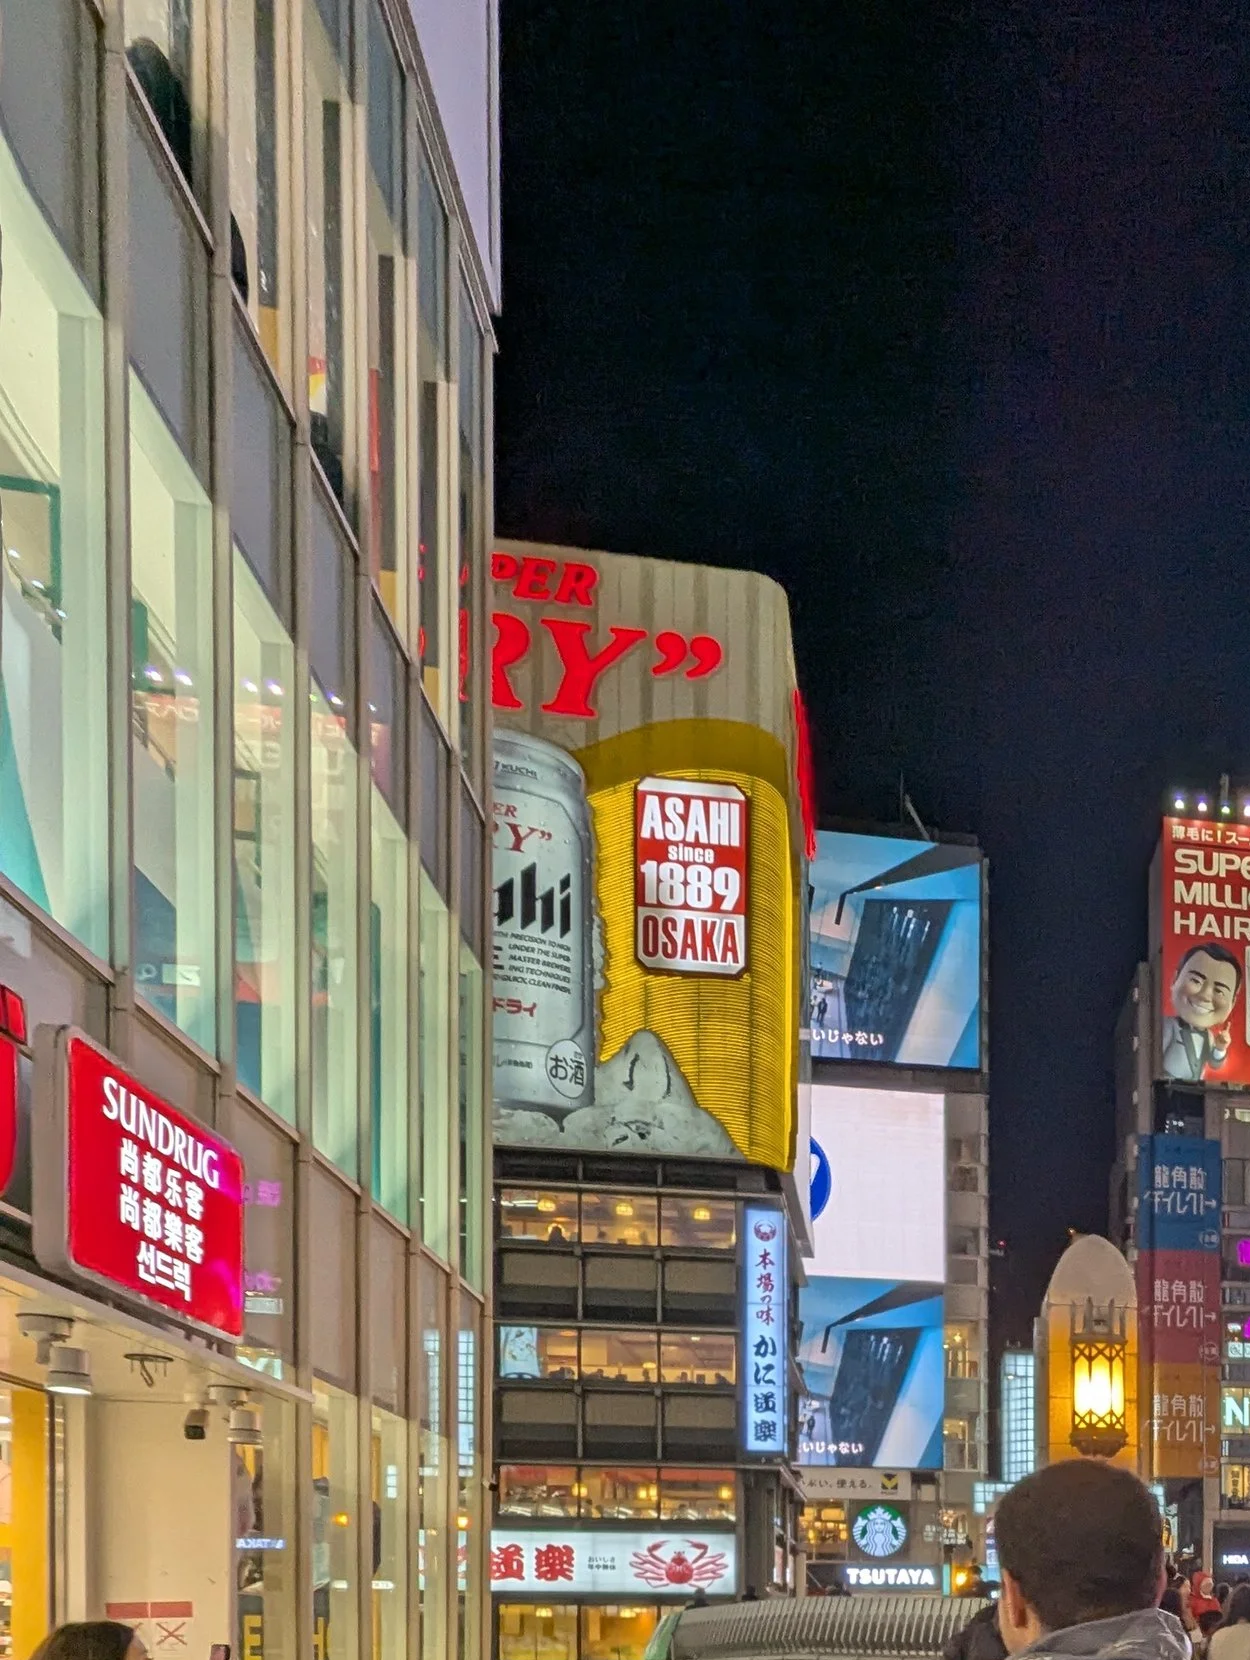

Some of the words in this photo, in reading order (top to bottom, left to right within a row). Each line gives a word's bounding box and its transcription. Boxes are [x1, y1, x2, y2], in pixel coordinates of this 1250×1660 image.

[640, 795, 740, 847] ASAHI
[668, 843, 714, 864] since
[640, 860, 741, 911] 1889
[642, 914, 740, 965] OSAKA
[102, 1076, 220, 1189] SUNDRUG
[119, 1137, 204, 1221] 尚都乐客
[119, 1182, 204, 1264] 尚都樂客
[136, 1240, 192, 1302] 선드럭
[754, 1248, 776, 1327] 本場の味
[846, 1568, 935, 1586] TSUTAYA
